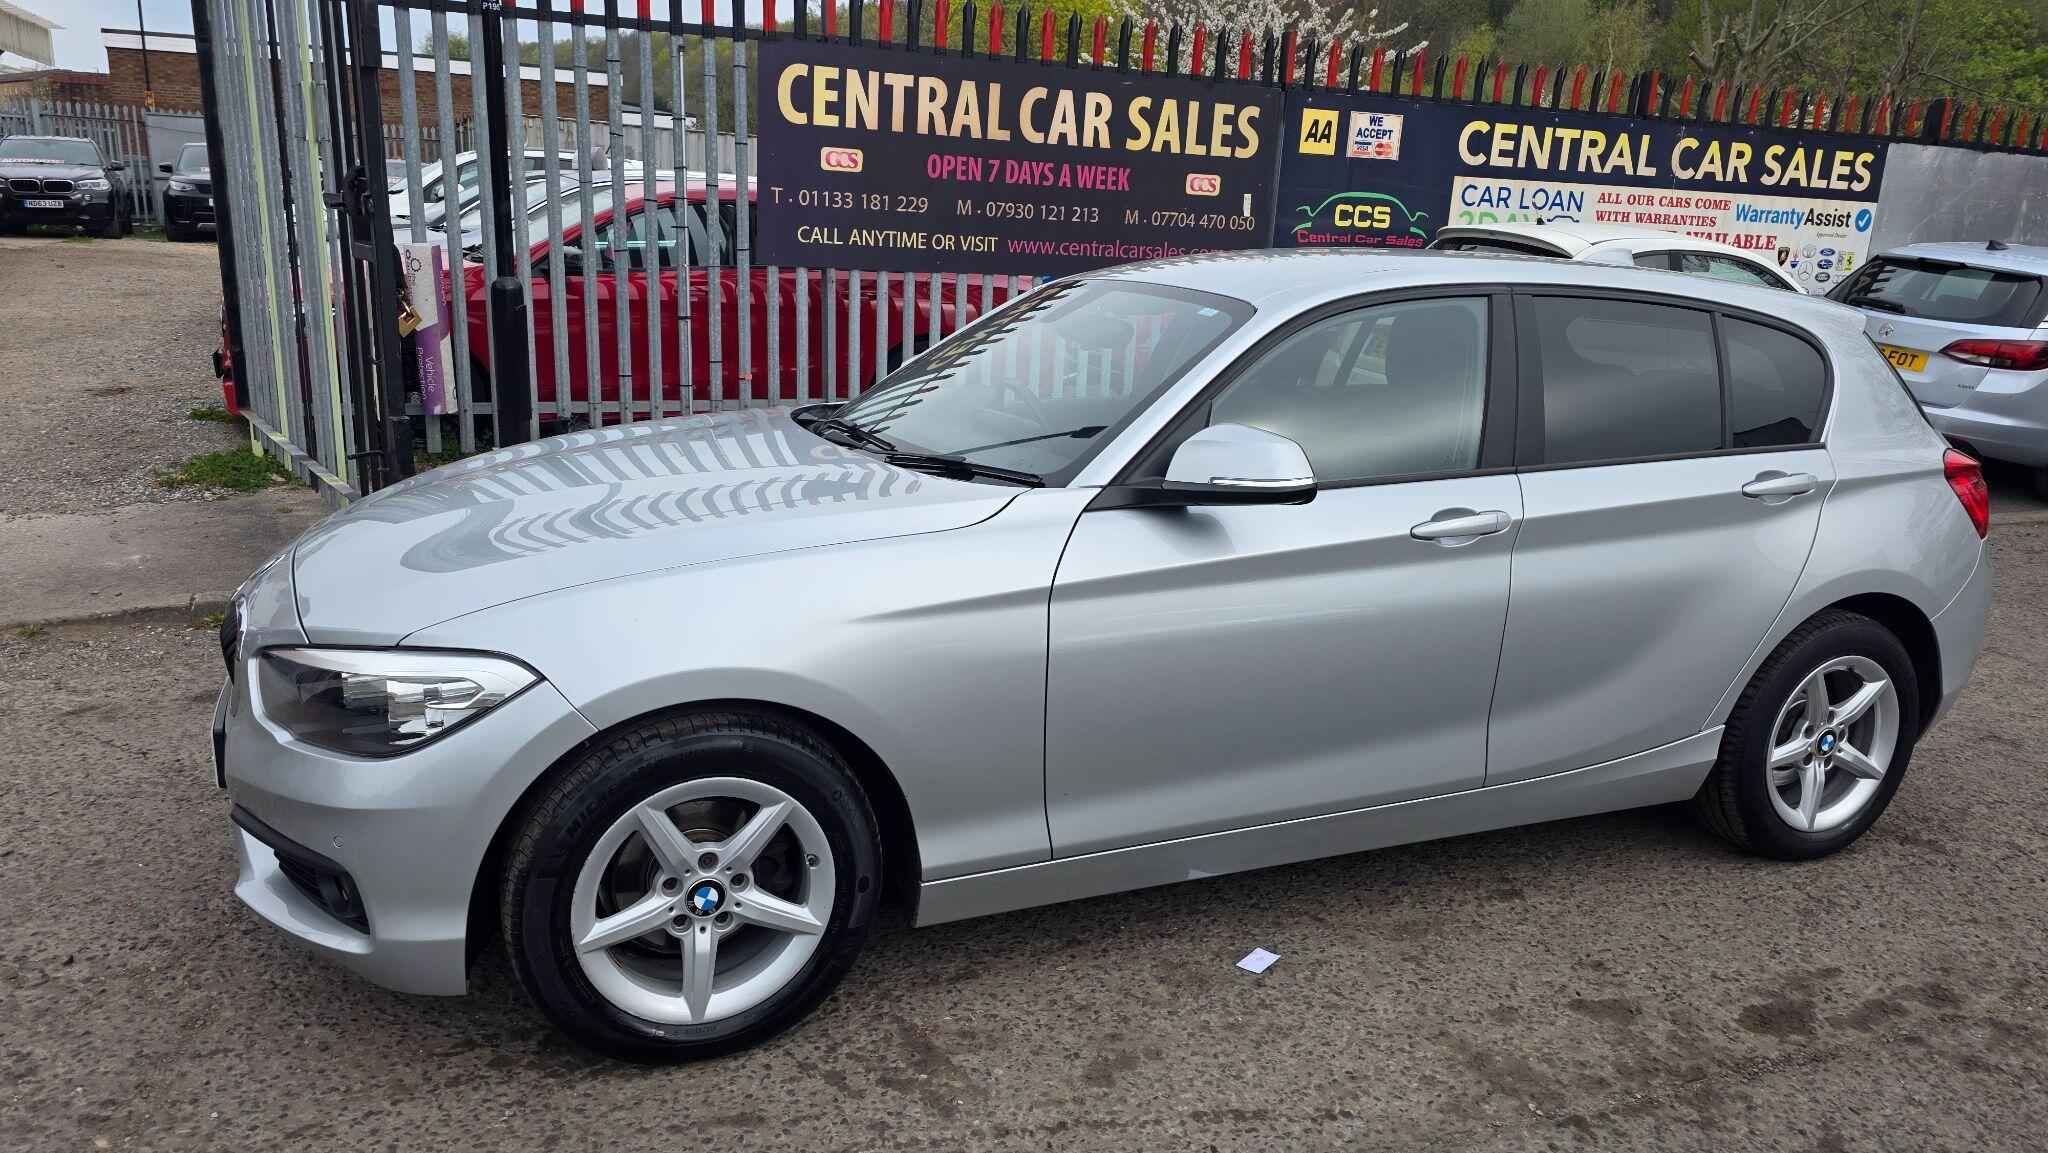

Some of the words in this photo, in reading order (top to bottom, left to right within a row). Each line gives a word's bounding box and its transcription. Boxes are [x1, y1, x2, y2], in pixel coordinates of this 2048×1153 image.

[482, 2, 500, 10] P195
[777, 63, 1011, 141] CENTRAL
[1019, 87, 1113, 149] CAR
[1125, 96, 1260, 159] SALES
[1369, 116, 1383, 127] WE
[1304, 119, 1332, 144] AA
[1356, 128, 1393, 140] ACCEPT
[1458, 120, 1657, 177] CENTRAL
[1671, 137, 1752, 183] CAR
[1760, 144, 1875, 192] SALES
[927, 153, 982, 182] OPEN
[988, 159, 1000, 183] 7
[1005, 159, 1055, 187] DAYS
[1058, 163, 1072, 188] A
[1076, 164, 1132, 192] WEEK
[799, 189, 853, 209] 01133
[861, 193, 889, 211] 181
[896, 195, 929, 213] 229
[1461, 183, 1511, 209] CAR
[1520, 187, 1585, 213] LOAN
[1597, 192, 1622, 205] ALL
[1626, 193, 1655, 207] OUR
[1659, 195, 1691, 209] CARS
[1695, 198, 1732, 211] COME
[986, 201, 1034, 219] 07930
[1040, 204, 1065, 221] 121
[1072, 206, 1099, 223] 213
[1152, 210, 1195, 228] 07704
[1199, 214, 1226, 229] 470
[1229, 215, 1255, 231] 050
[1334, 204, 1391, 229] CCS
[1595, 210, 1631, 223] WITH
[1635, 212, 1717, 227] WARRANTIES
[797, 226, 843, 245] CALL
[849, 228, 927, 249] ANYTIME
[932, 234, 955, 250] OR
[960, 235, 998, 252] VISIT
[1296, 229, 1351, 244] Central
[1355, 234, 1381, 244] Car
[1385, 235, 1424, 248] Sales
[424, 357, 435, 393] Vehicle
